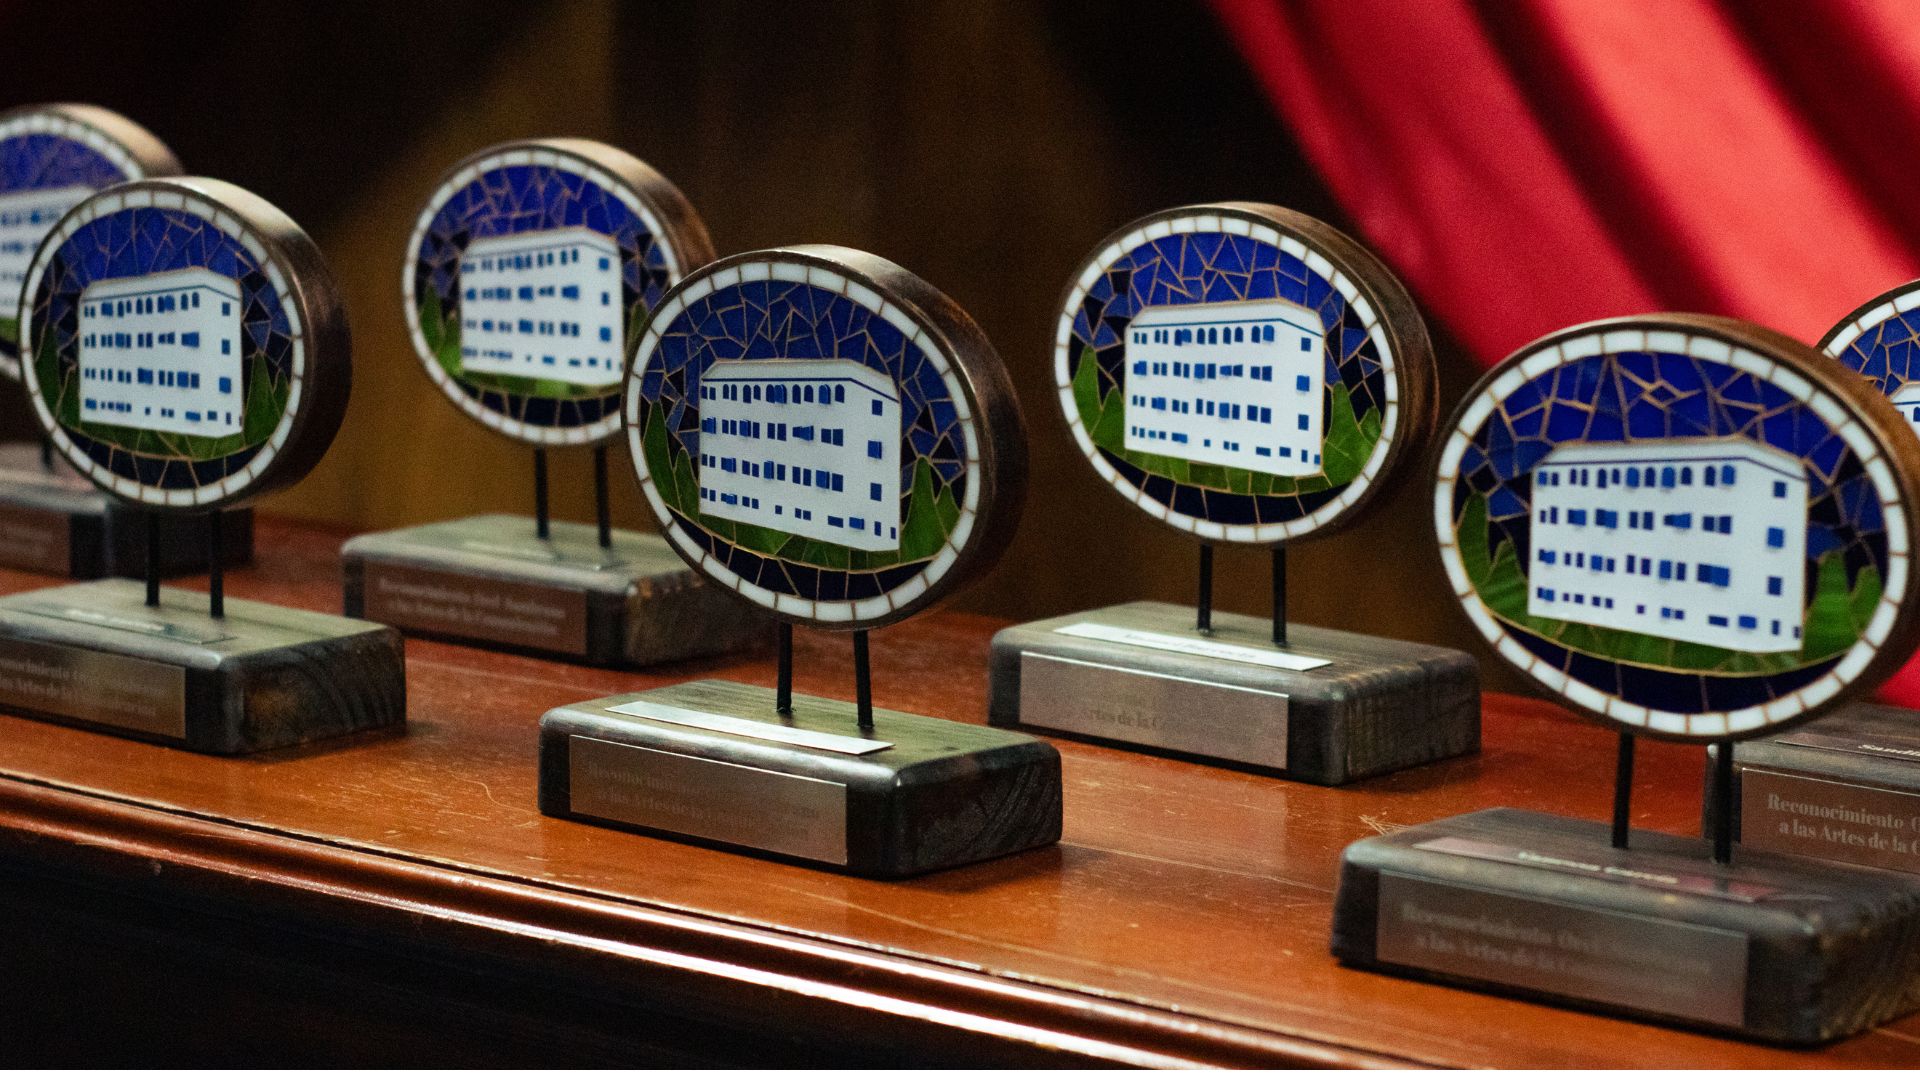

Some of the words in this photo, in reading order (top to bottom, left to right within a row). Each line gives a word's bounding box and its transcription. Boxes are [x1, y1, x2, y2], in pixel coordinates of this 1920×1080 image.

[1767, 793, 1904, 830] Reconocimiento
[1779, 821, 1789, 835] a
[1793, 819, 1817, 838] las
[1819, 825, 1866, 847] Artes
[1868, 831, 1887, 850] de
[1893, 835, 1908, 854] la
